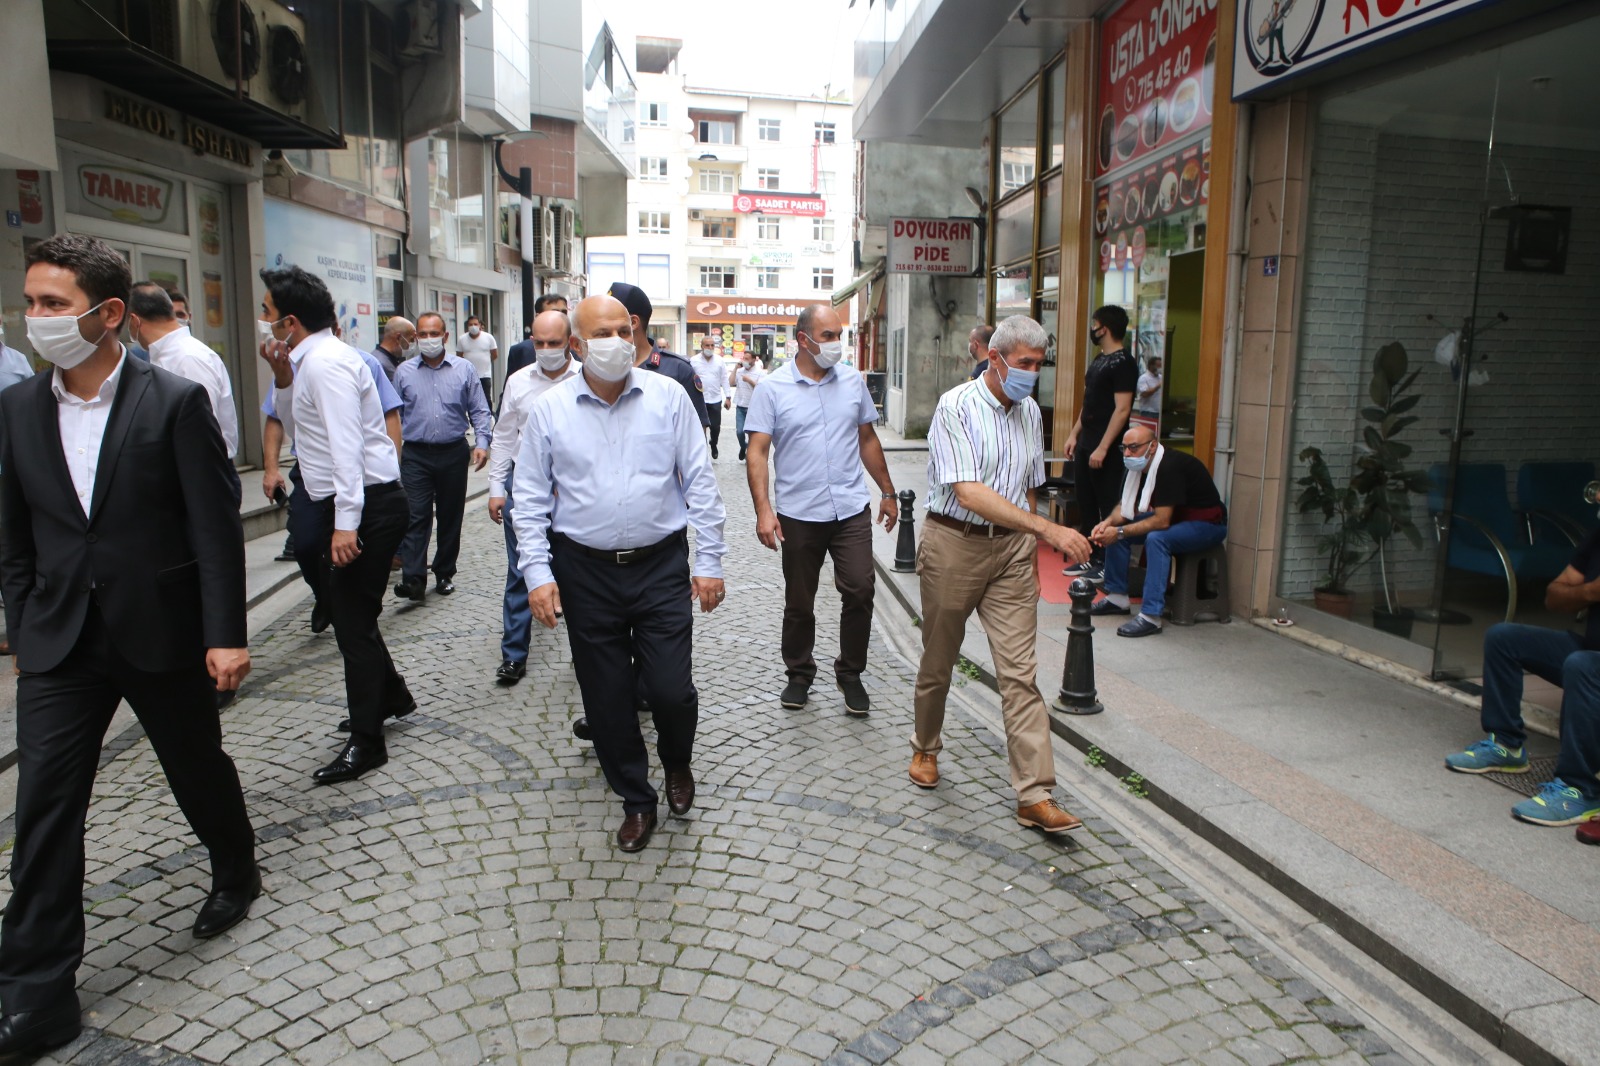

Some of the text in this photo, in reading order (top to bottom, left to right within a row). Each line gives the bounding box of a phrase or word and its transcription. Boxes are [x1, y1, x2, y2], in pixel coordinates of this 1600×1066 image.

[1109, 20, 1145, 85] USTA
[1137, 45, 1191, 104] 715 45 40
[107, 93, 175, 140] EKOL
[83, 171, 162, 209] TAMEK
[755, 199, 789, 209] SAADET
[12, 215, 17, 224] 2
[894, 220, 971, 241] DOYURAN
[914, 242, 950, 262] PİDE
[327, 269, 347, 280] KEPEKLE
[338, 259, 360, 270] KURULUK
[360, 264, 366, 273] VE
[727, 303, 806, 316] gündoğdu
